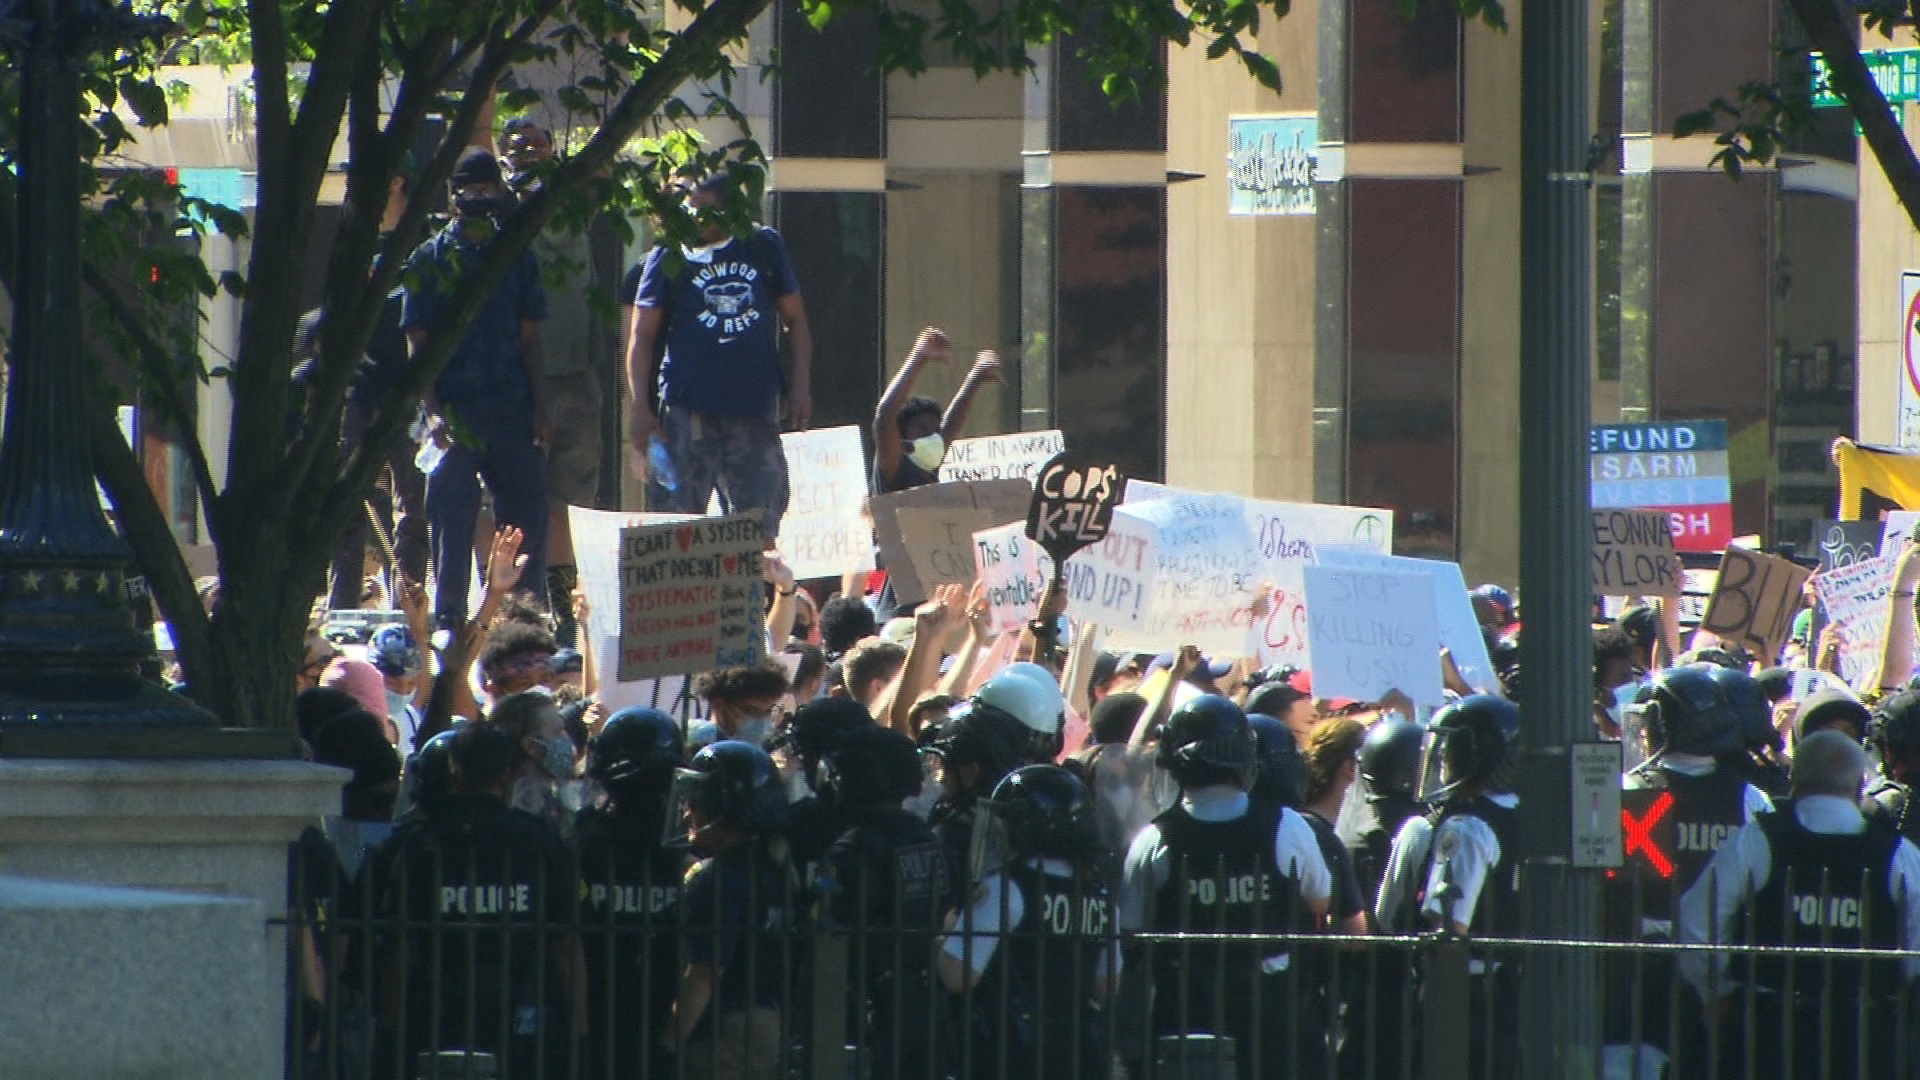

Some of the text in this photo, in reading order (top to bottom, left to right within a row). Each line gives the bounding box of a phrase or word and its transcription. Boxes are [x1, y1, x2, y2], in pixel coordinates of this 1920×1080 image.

[696, 307, 760, 333] NO REFS
[986, 440, 1006, 460] IN
[1591, 427, 1697, 451] EFUND
[1042, 463, 1118, 502] COPS
[692, 525, 704, 545] A
[707, 518, 764, 545] SYSTEM
[1037, 500, 1105, 542] KILL
[1593, 511, 1674, 548] EONNA
[623, 560, 669, 588] THAT
[737, 551, 762, 578] ME
[1592, 550, 1674, 587] YLOR
[626, 584, 718, 614] SYSTEMATIC
[1103, 568, 1143, 620] UP!
[1312, 614, 1415, 649] KILLING
[1187, 873, 1271, 906] POICE
[1043, 893, 1109, 936] POICE
